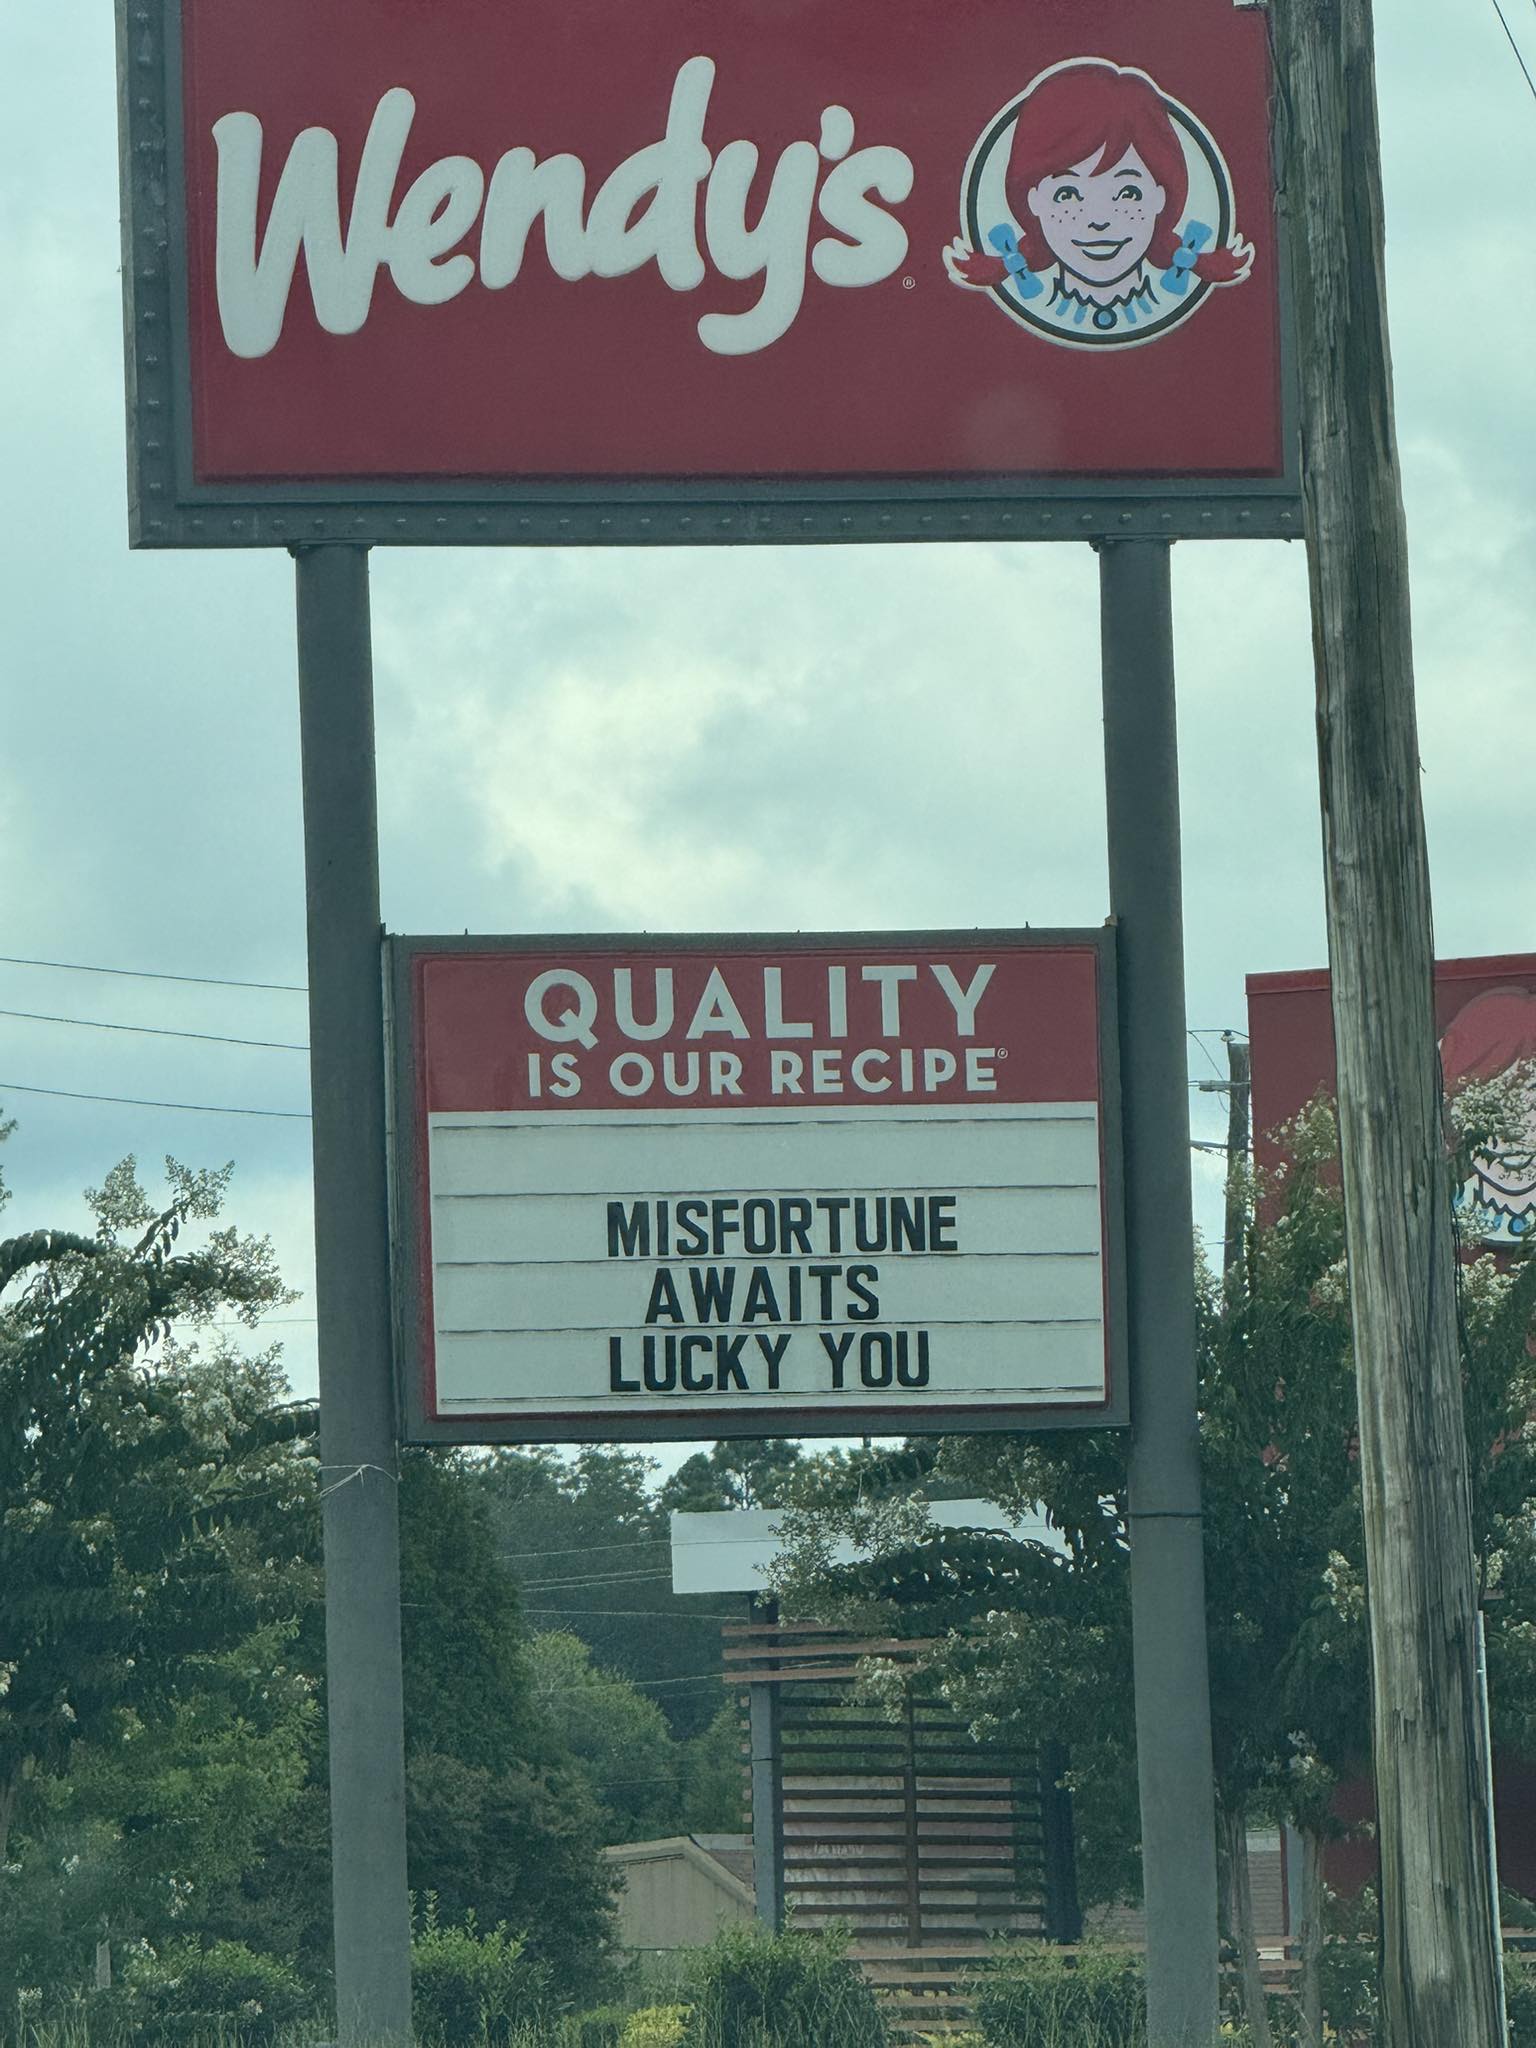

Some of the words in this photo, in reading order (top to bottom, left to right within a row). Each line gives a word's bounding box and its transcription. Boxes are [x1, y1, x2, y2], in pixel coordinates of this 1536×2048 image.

[211, 55, 915, 359] Wendy's
[523, 964, 997, 1051] QUALITY
[527, 1052, 582, 1098] IS
[609, 1051, 744, 1097] OUR
[770, 1047, 998, 1095] RECIPE
[606, 1195, 958, 1258] MISFORTUNE
[644, 1264, 880, 1325] AWAITS
[608, 1333, 792, 1393] LUCKY
[818, 1330, 930, 1390] YOU
